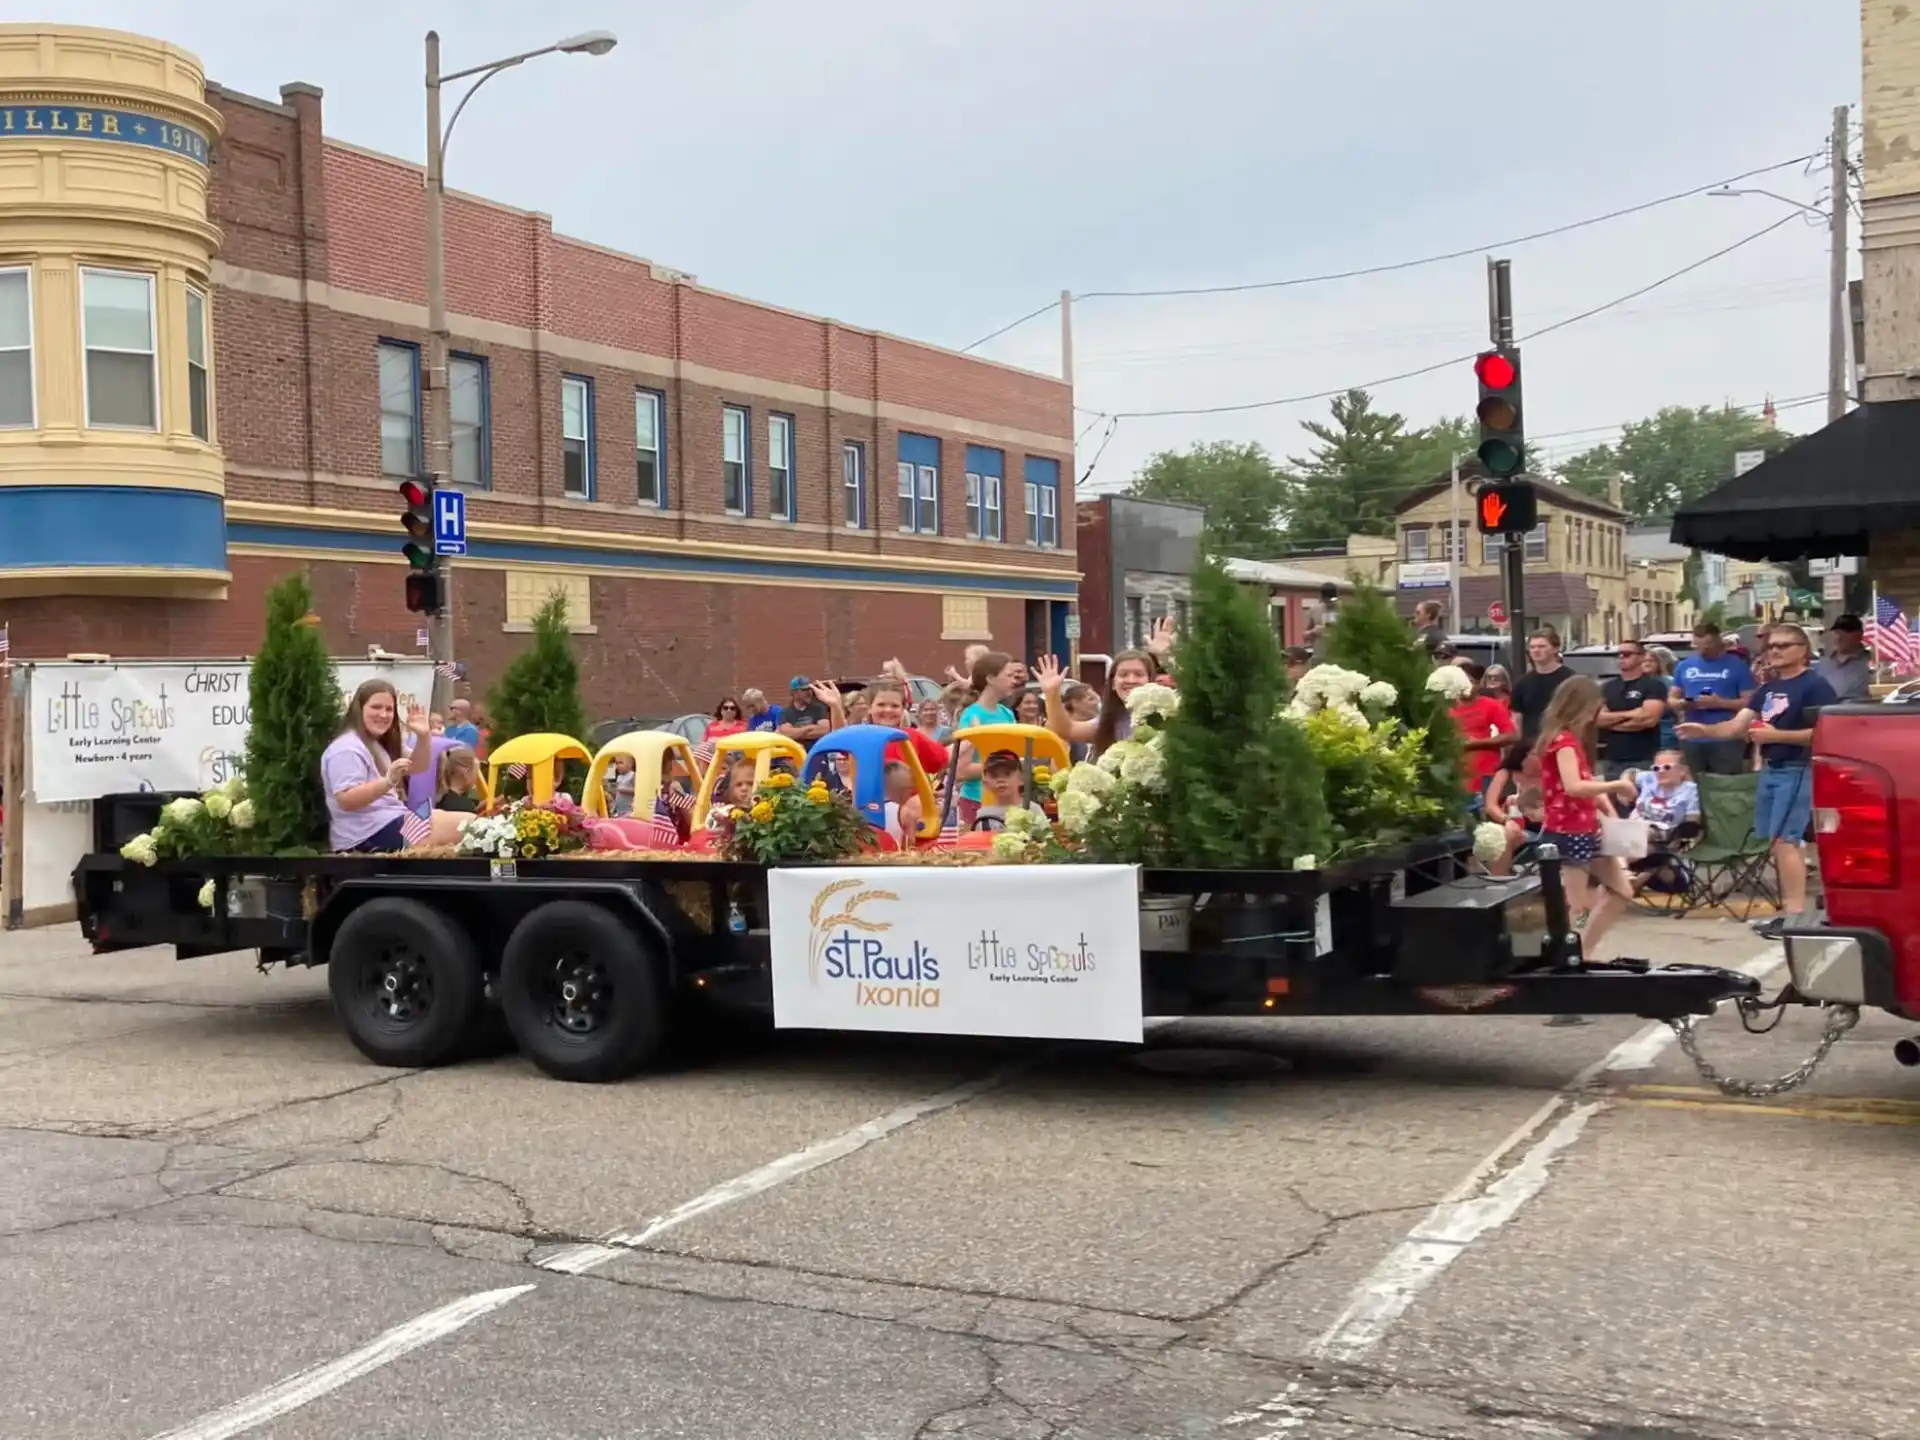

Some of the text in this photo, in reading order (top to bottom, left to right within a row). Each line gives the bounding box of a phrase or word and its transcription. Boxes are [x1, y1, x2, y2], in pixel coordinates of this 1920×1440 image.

[441, 497, 459, 536] H
[185, 672, 242, 693] CHRIST
[111, 682, 175, 736] Sprouts
[69, 734, 161, 748] Early Learning Center
[74, 753, 114, 764] Newborn
[121, 751, 127, 761] 4
[129, 752, 152, 763] years
[1027, 932, 1096, 976] Sprouts
[989, 973, 1079, 984] Early Learning Center
[856, 982, 941, 1008] Ixonia
